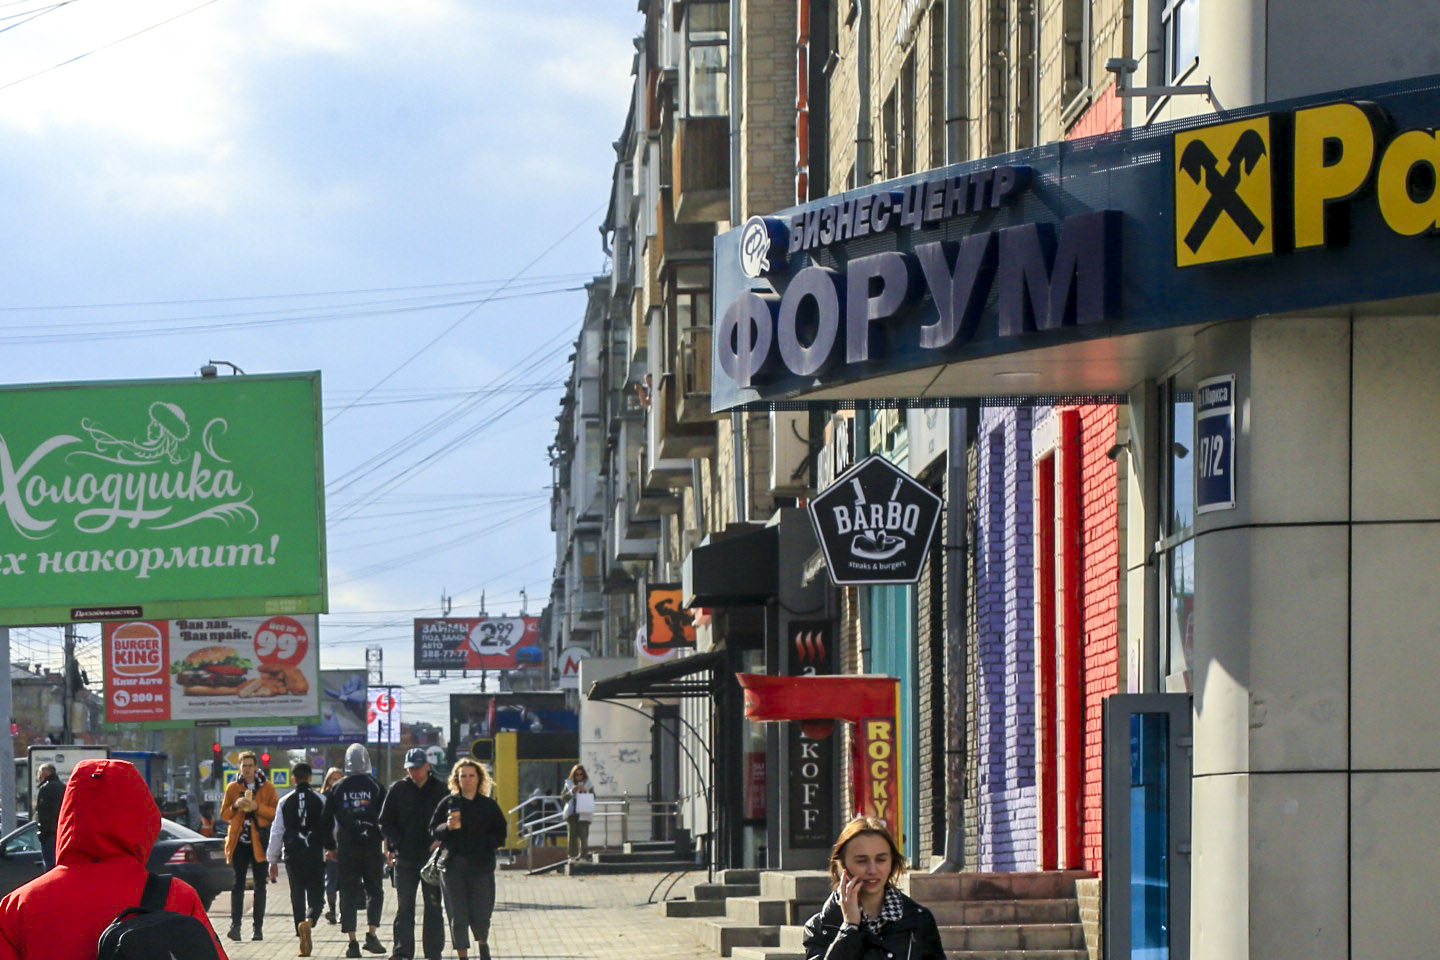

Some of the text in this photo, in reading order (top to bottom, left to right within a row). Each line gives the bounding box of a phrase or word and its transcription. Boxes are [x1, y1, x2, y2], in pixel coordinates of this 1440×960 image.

[788, 166, 1016, 254] БИЗНЕС-ЦЕНТР
[717, 210, 1108, 389] ФОРУМ
[833, 501, 920, 536] BARBQ
[39, 534, 280, 579] накормит!
[849, 560, 907, 571] steaks & burgers
[176, 619, 232, 630] Ван лав.
[180, 629, 253, 642] Ван прайс.
[422, 622, 469, 633] ЗАЙМЫ
[480, 623, 514, 646] 2 99
[114, 640, 159, 650] BURGER
[257, 630, 297, 659] 99
[114, 650, 159, 664] KING
[867, 721, 891, 820] ROCKY
